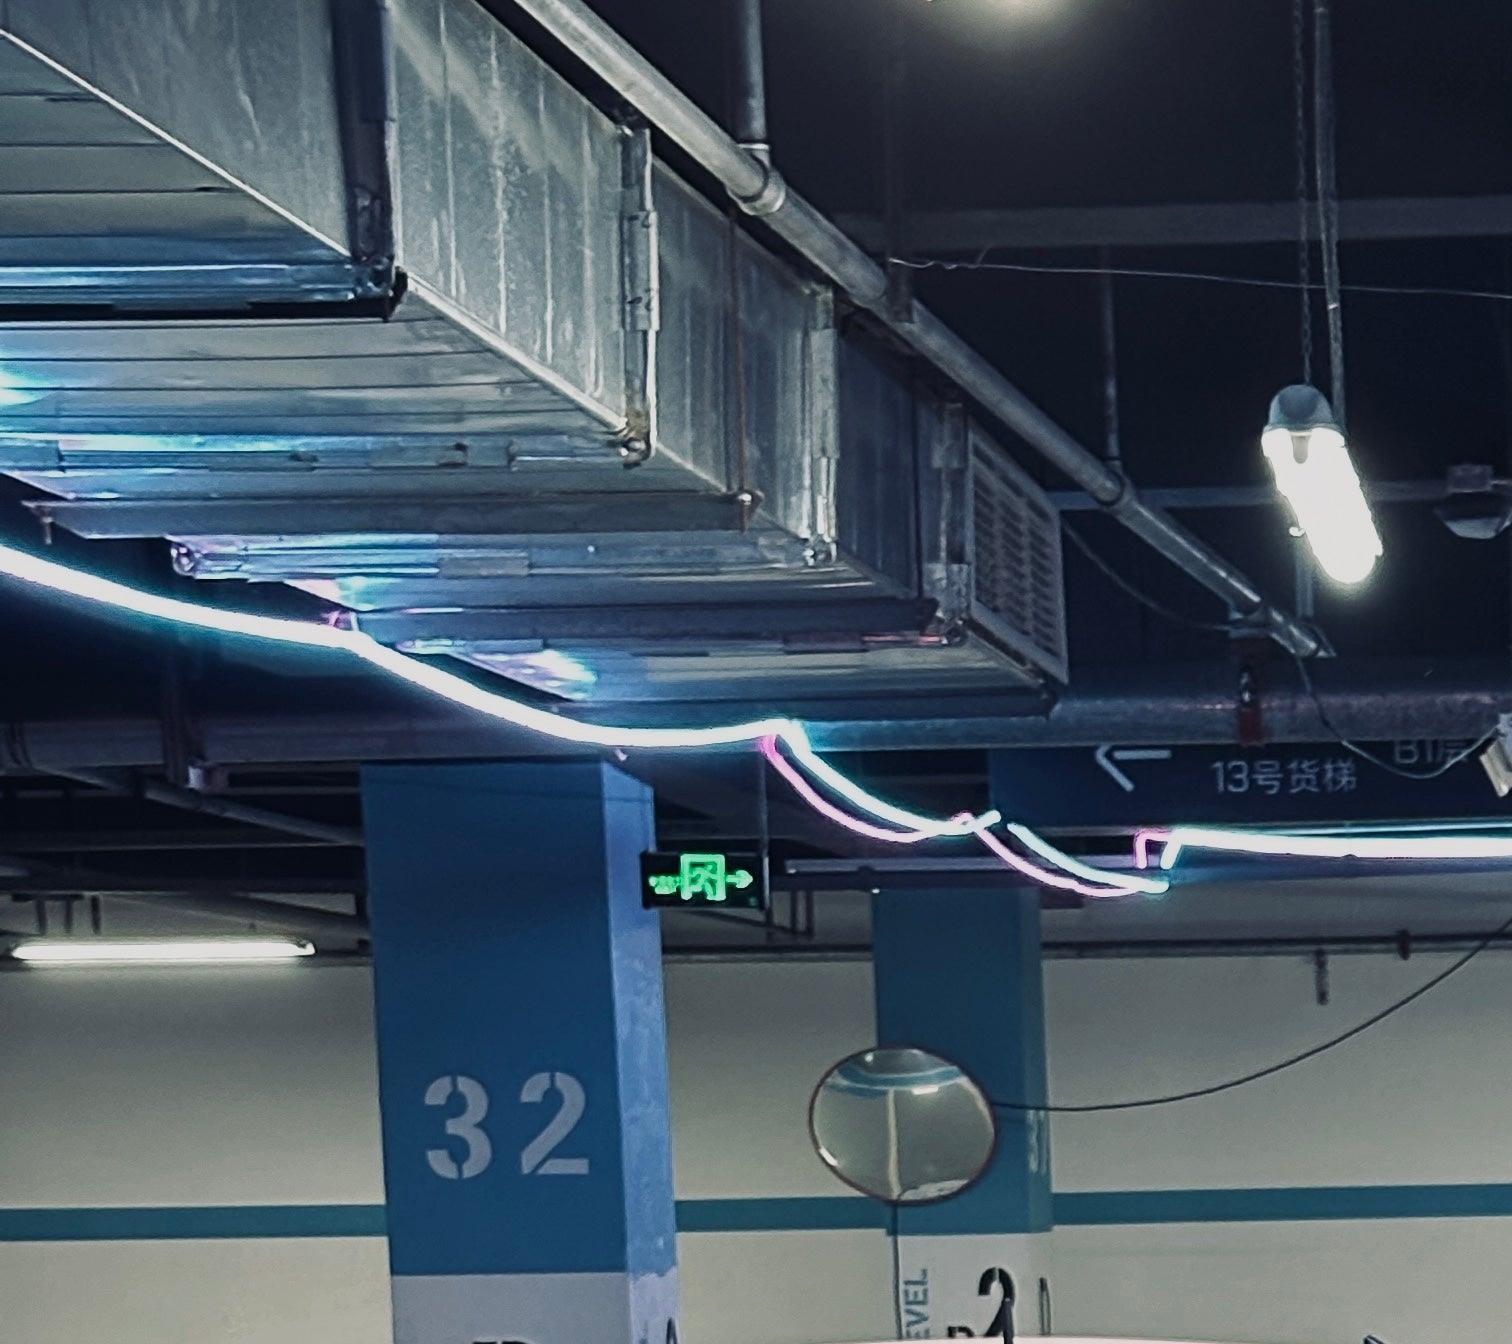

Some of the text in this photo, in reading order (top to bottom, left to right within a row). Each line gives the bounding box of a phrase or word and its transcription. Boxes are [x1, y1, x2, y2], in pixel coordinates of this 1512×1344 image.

[1211, 760, 1357, 794] 13号货梯
[423, 1071, 590, 1180] 32
[904, 1268, 930, 1338] EVEL
